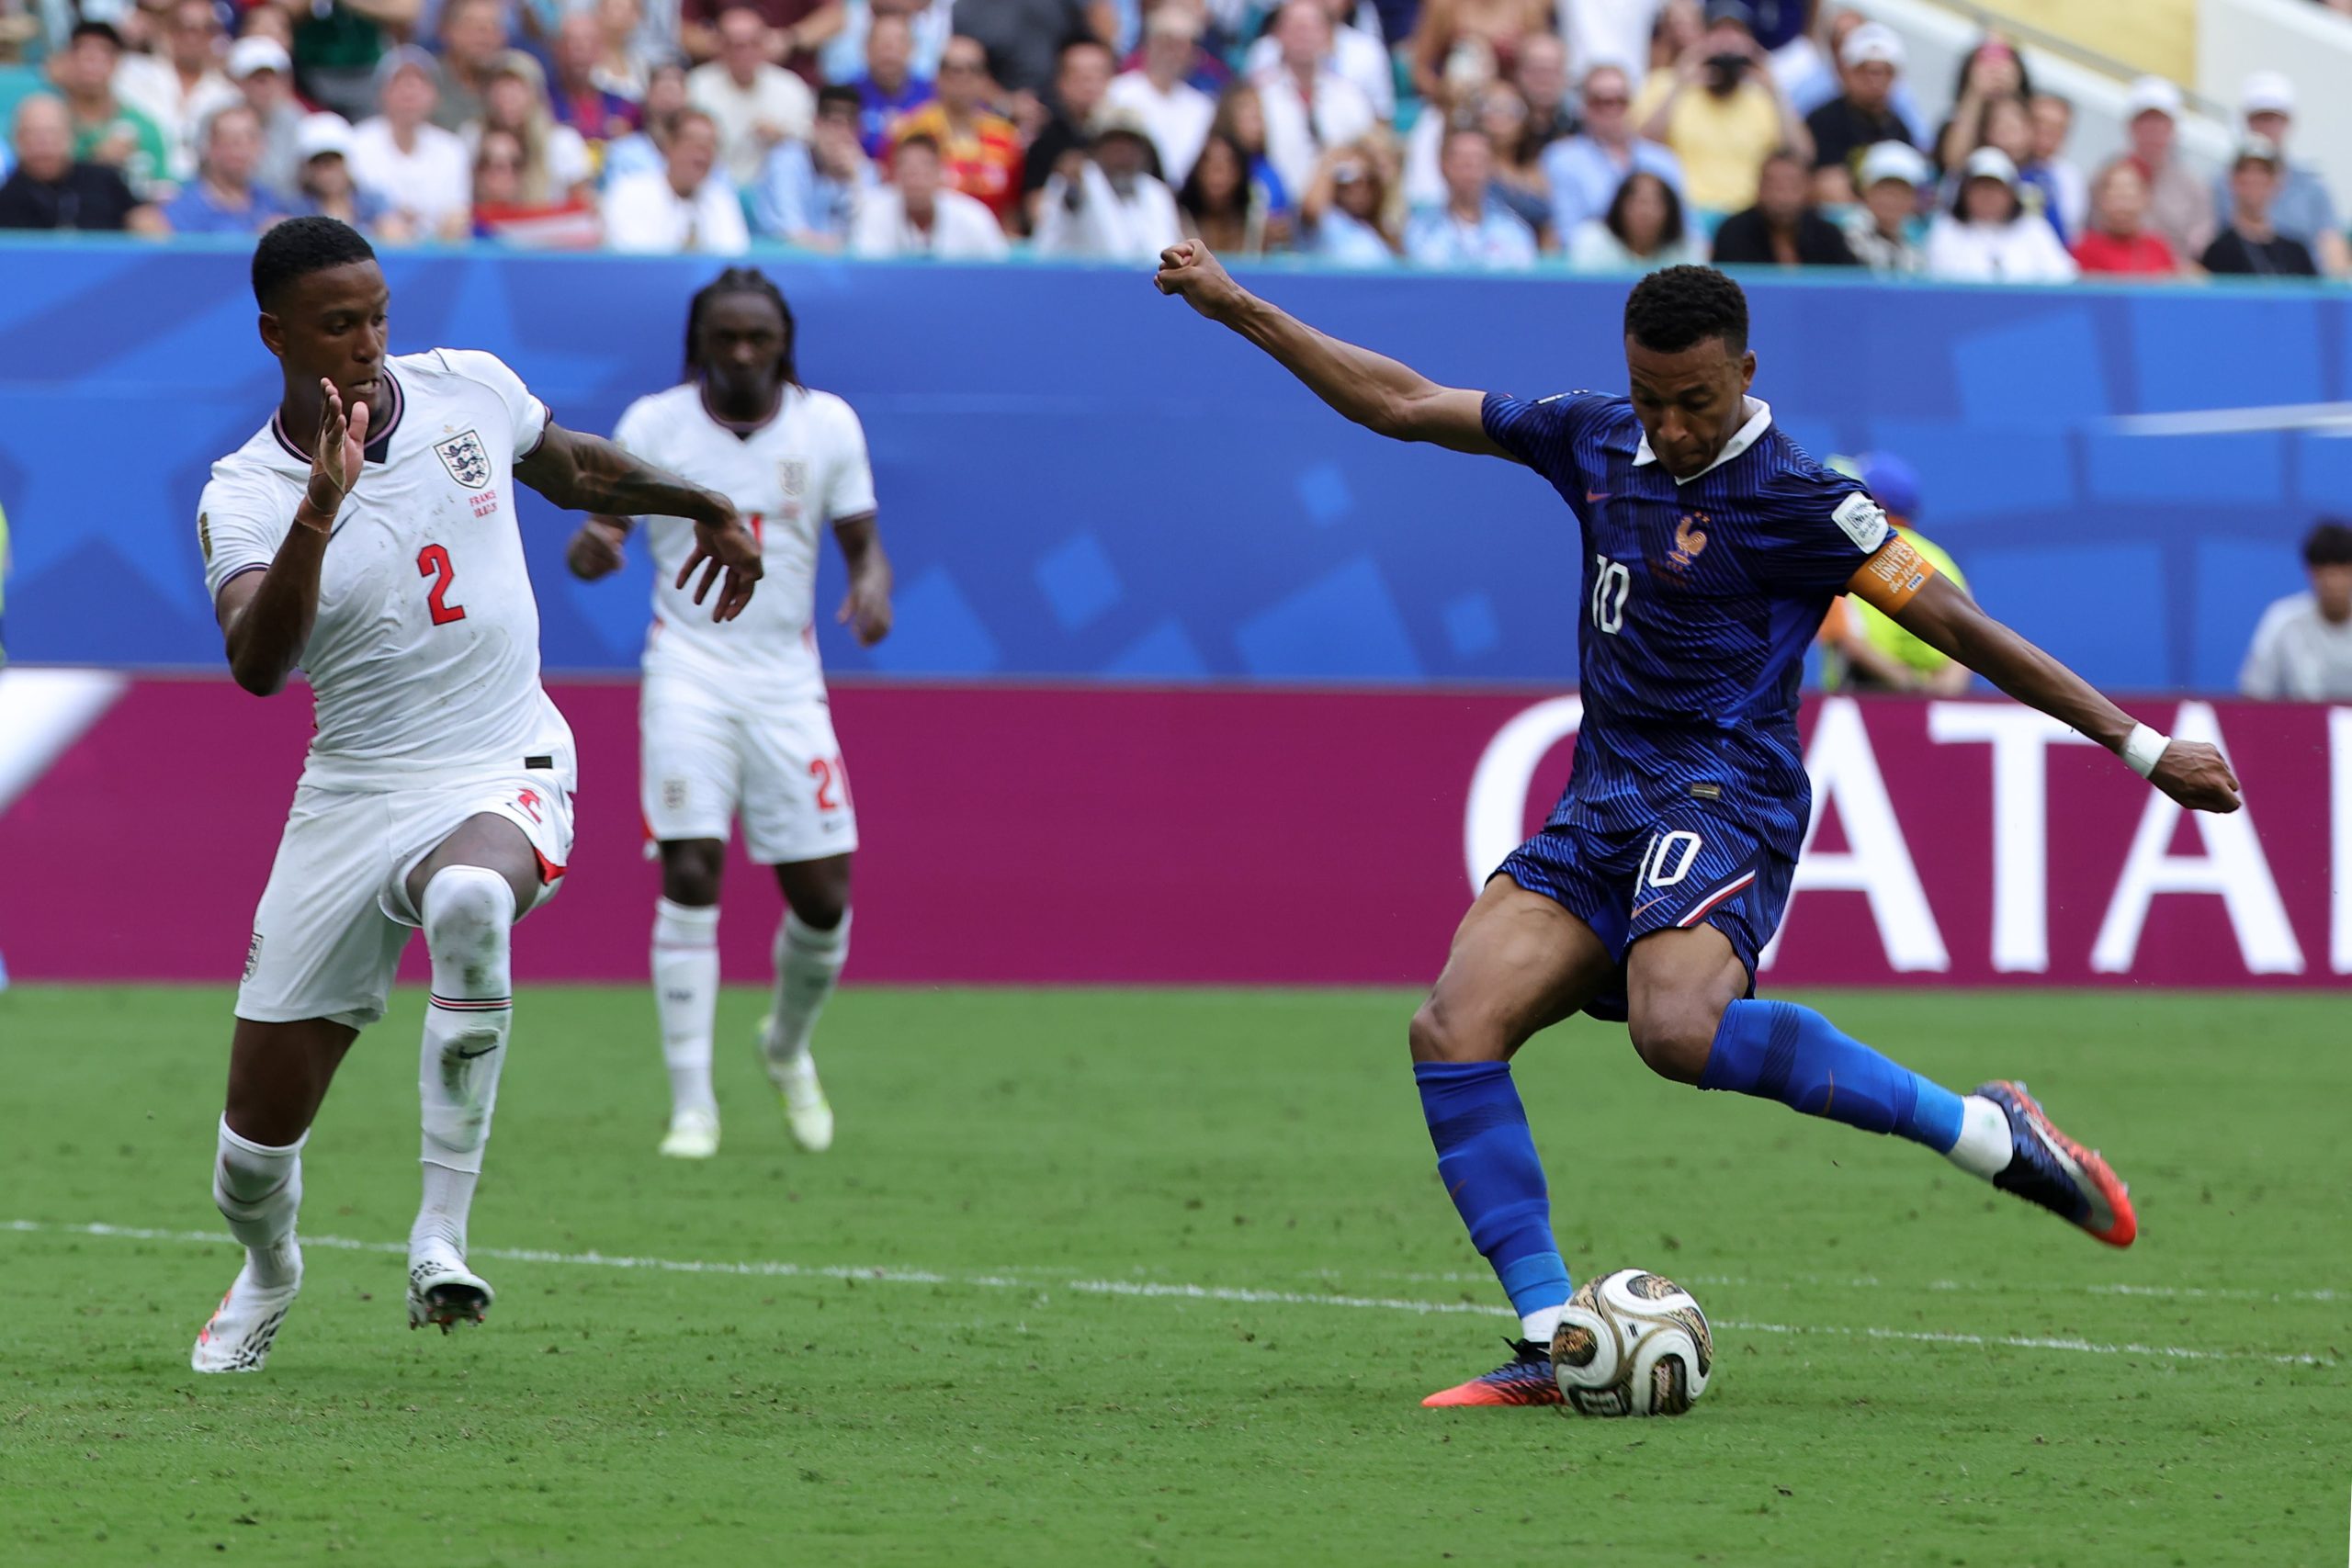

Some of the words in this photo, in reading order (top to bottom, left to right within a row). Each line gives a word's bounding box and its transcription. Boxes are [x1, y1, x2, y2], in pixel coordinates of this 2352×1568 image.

[416, 543, 467, 626] 2
[1592, 553, 1630, 636] 10
[1875, 543, 1914, 582] UNITES
[1463, 693, 2352, 976] ATA
[1634, 829, 1702, 898] 10
